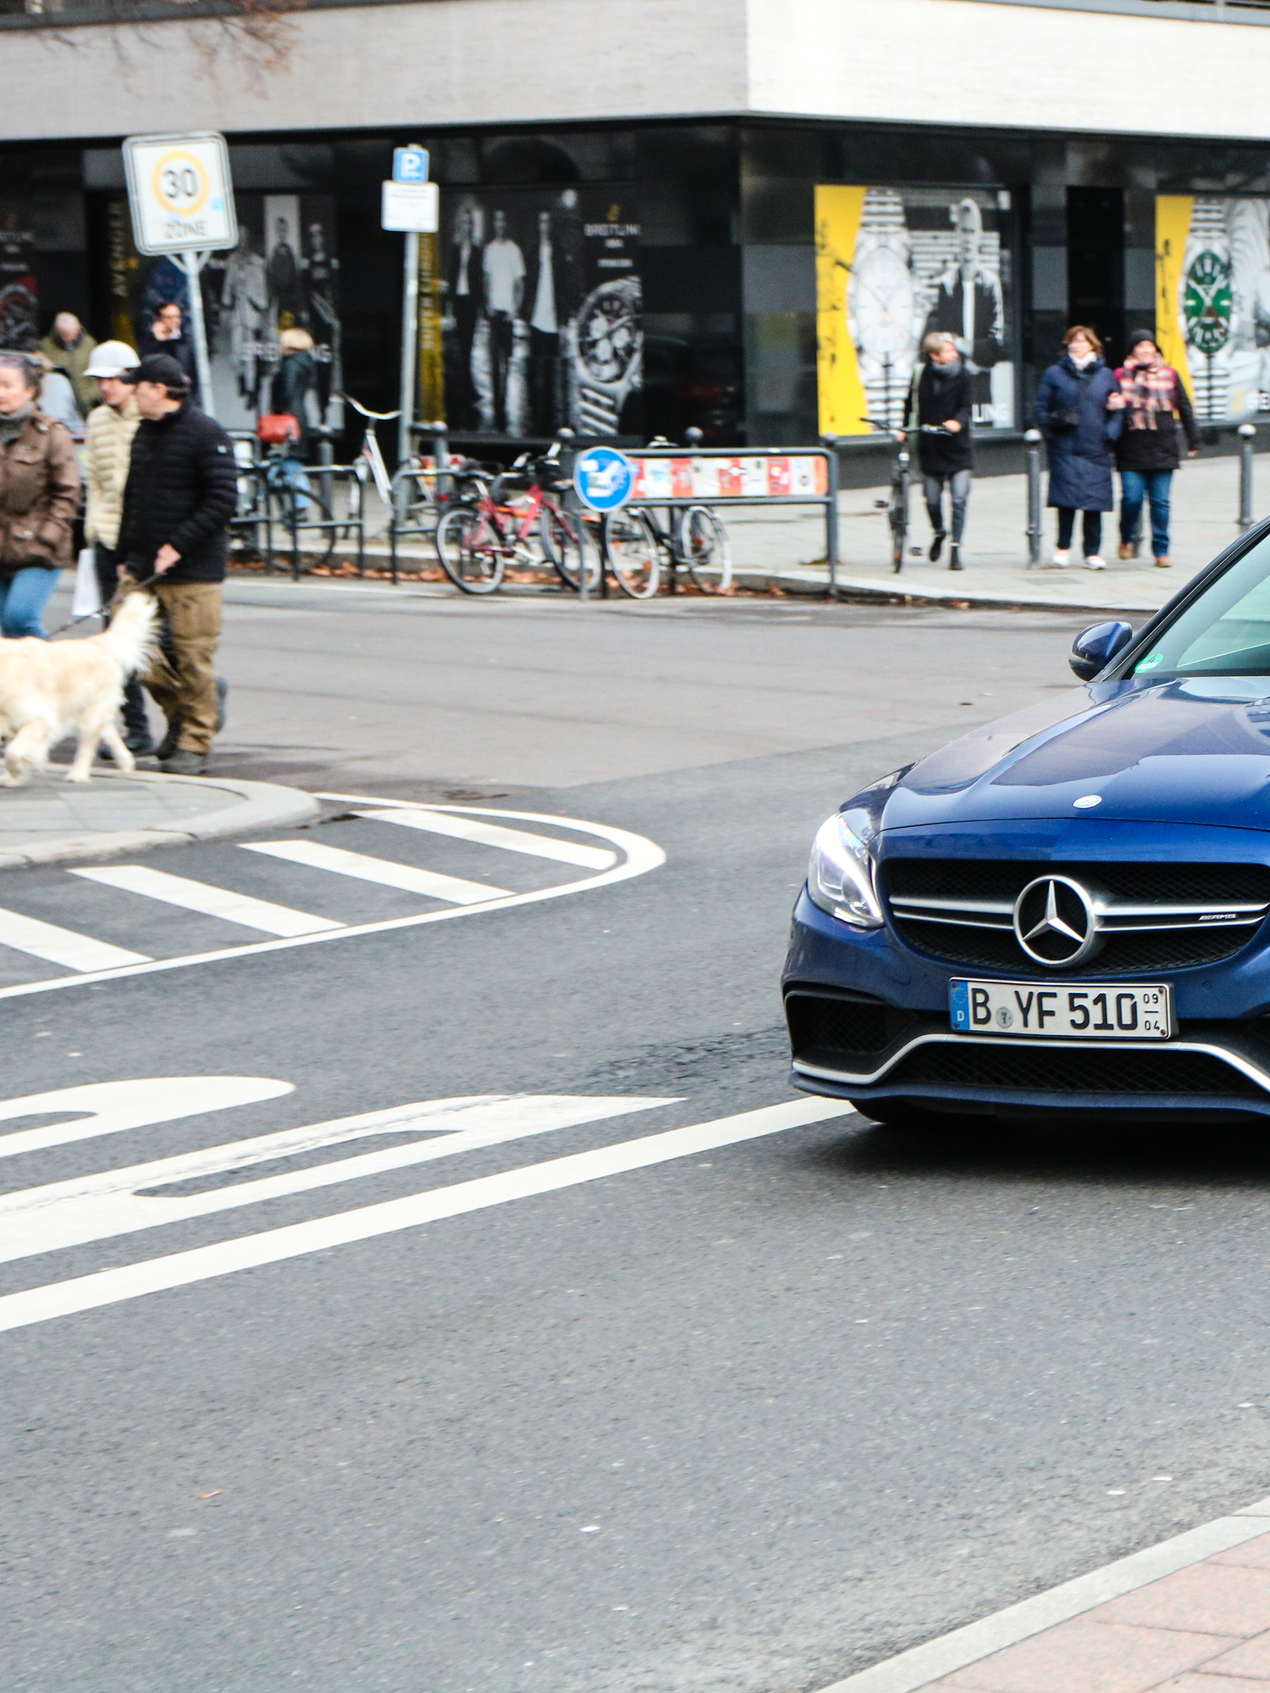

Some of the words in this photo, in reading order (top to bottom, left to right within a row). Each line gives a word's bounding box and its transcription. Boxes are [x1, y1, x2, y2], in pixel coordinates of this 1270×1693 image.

[401, 153, 421, 178] P
[163, 168, 197, 198] 30
[165, 220, 207, 239] ZONE
[1143, 993, 1159, 1004] 09
[957, 1010, 965, 1022] D
[971, 988, 992, 1025] B
[1014, 990, 1057, 1029] YF
[1068, 993, 1138, 1030] 510
[1144, 1020, 1160, 1031] 04
